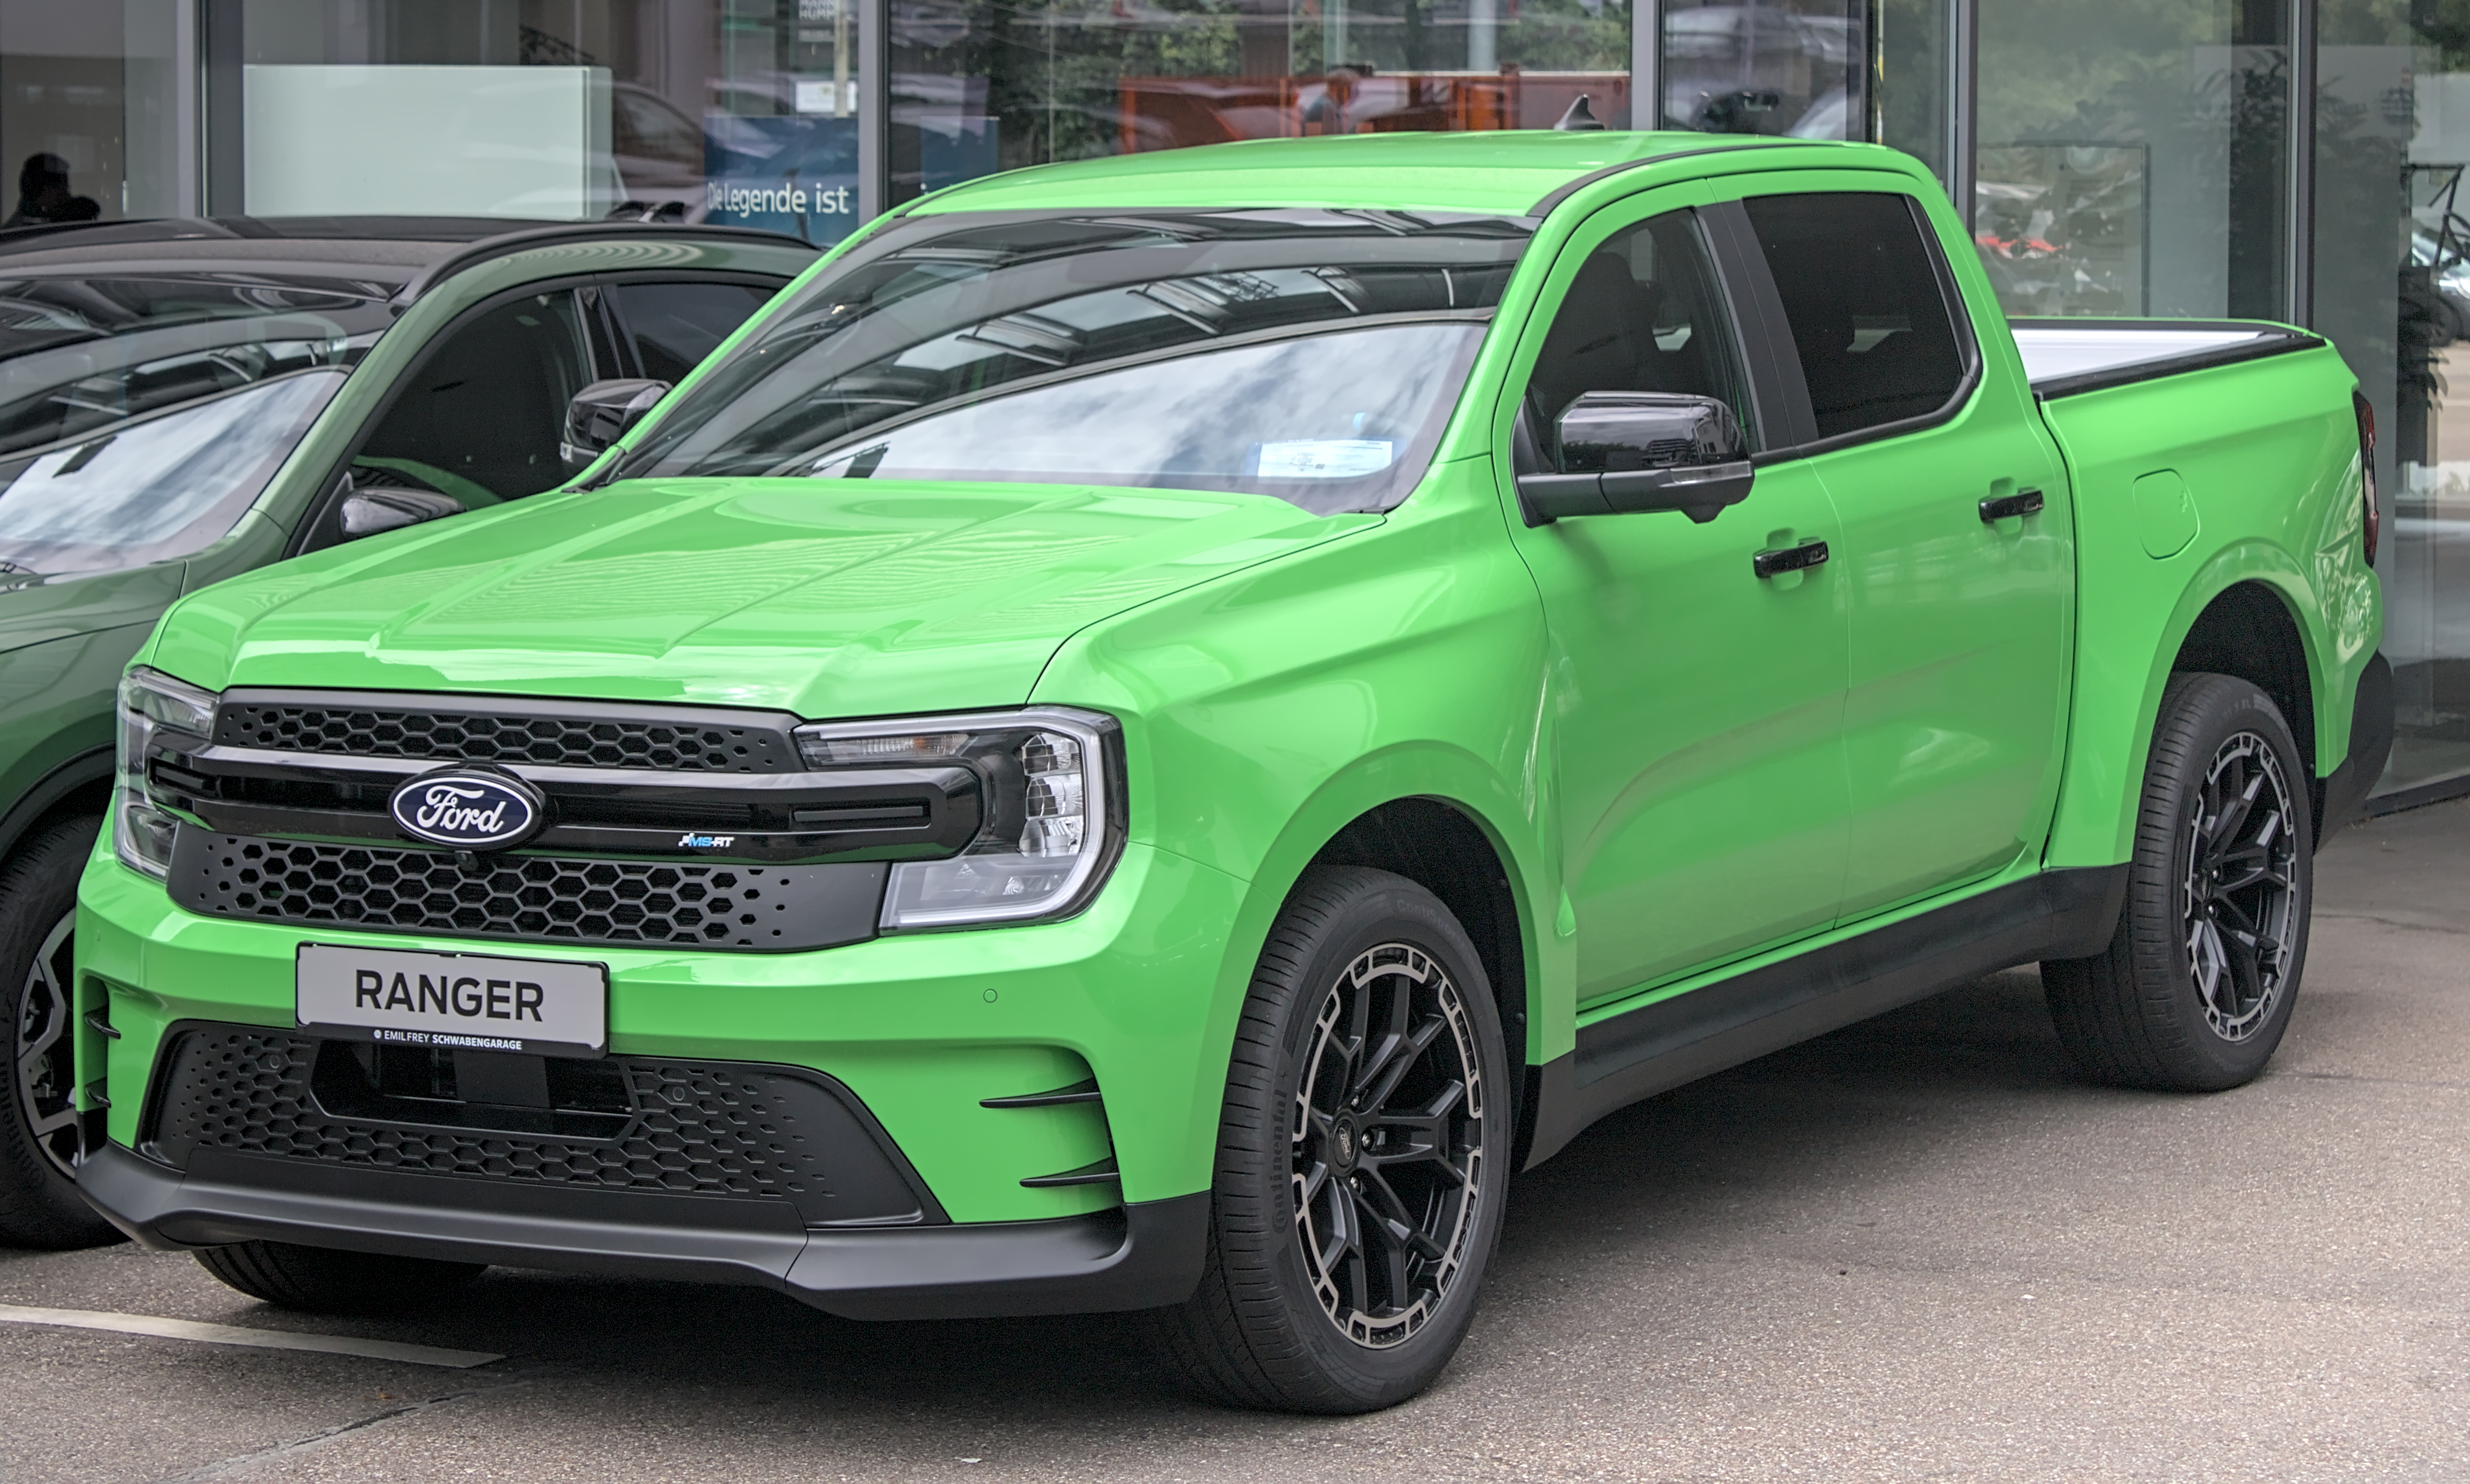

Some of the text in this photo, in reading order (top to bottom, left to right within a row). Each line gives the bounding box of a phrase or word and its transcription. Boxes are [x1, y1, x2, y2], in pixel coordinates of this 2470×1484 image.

[707, 181, 850, 218] Die Legende ist
[416, 784, 507, 833] Ford
[355, 969, 544, 1022] RANGER
[384, 1030, 522, 1050] EMIL FREY SCHWABENGARAGE
[1268, 1088, 1288, 1234] Continental
